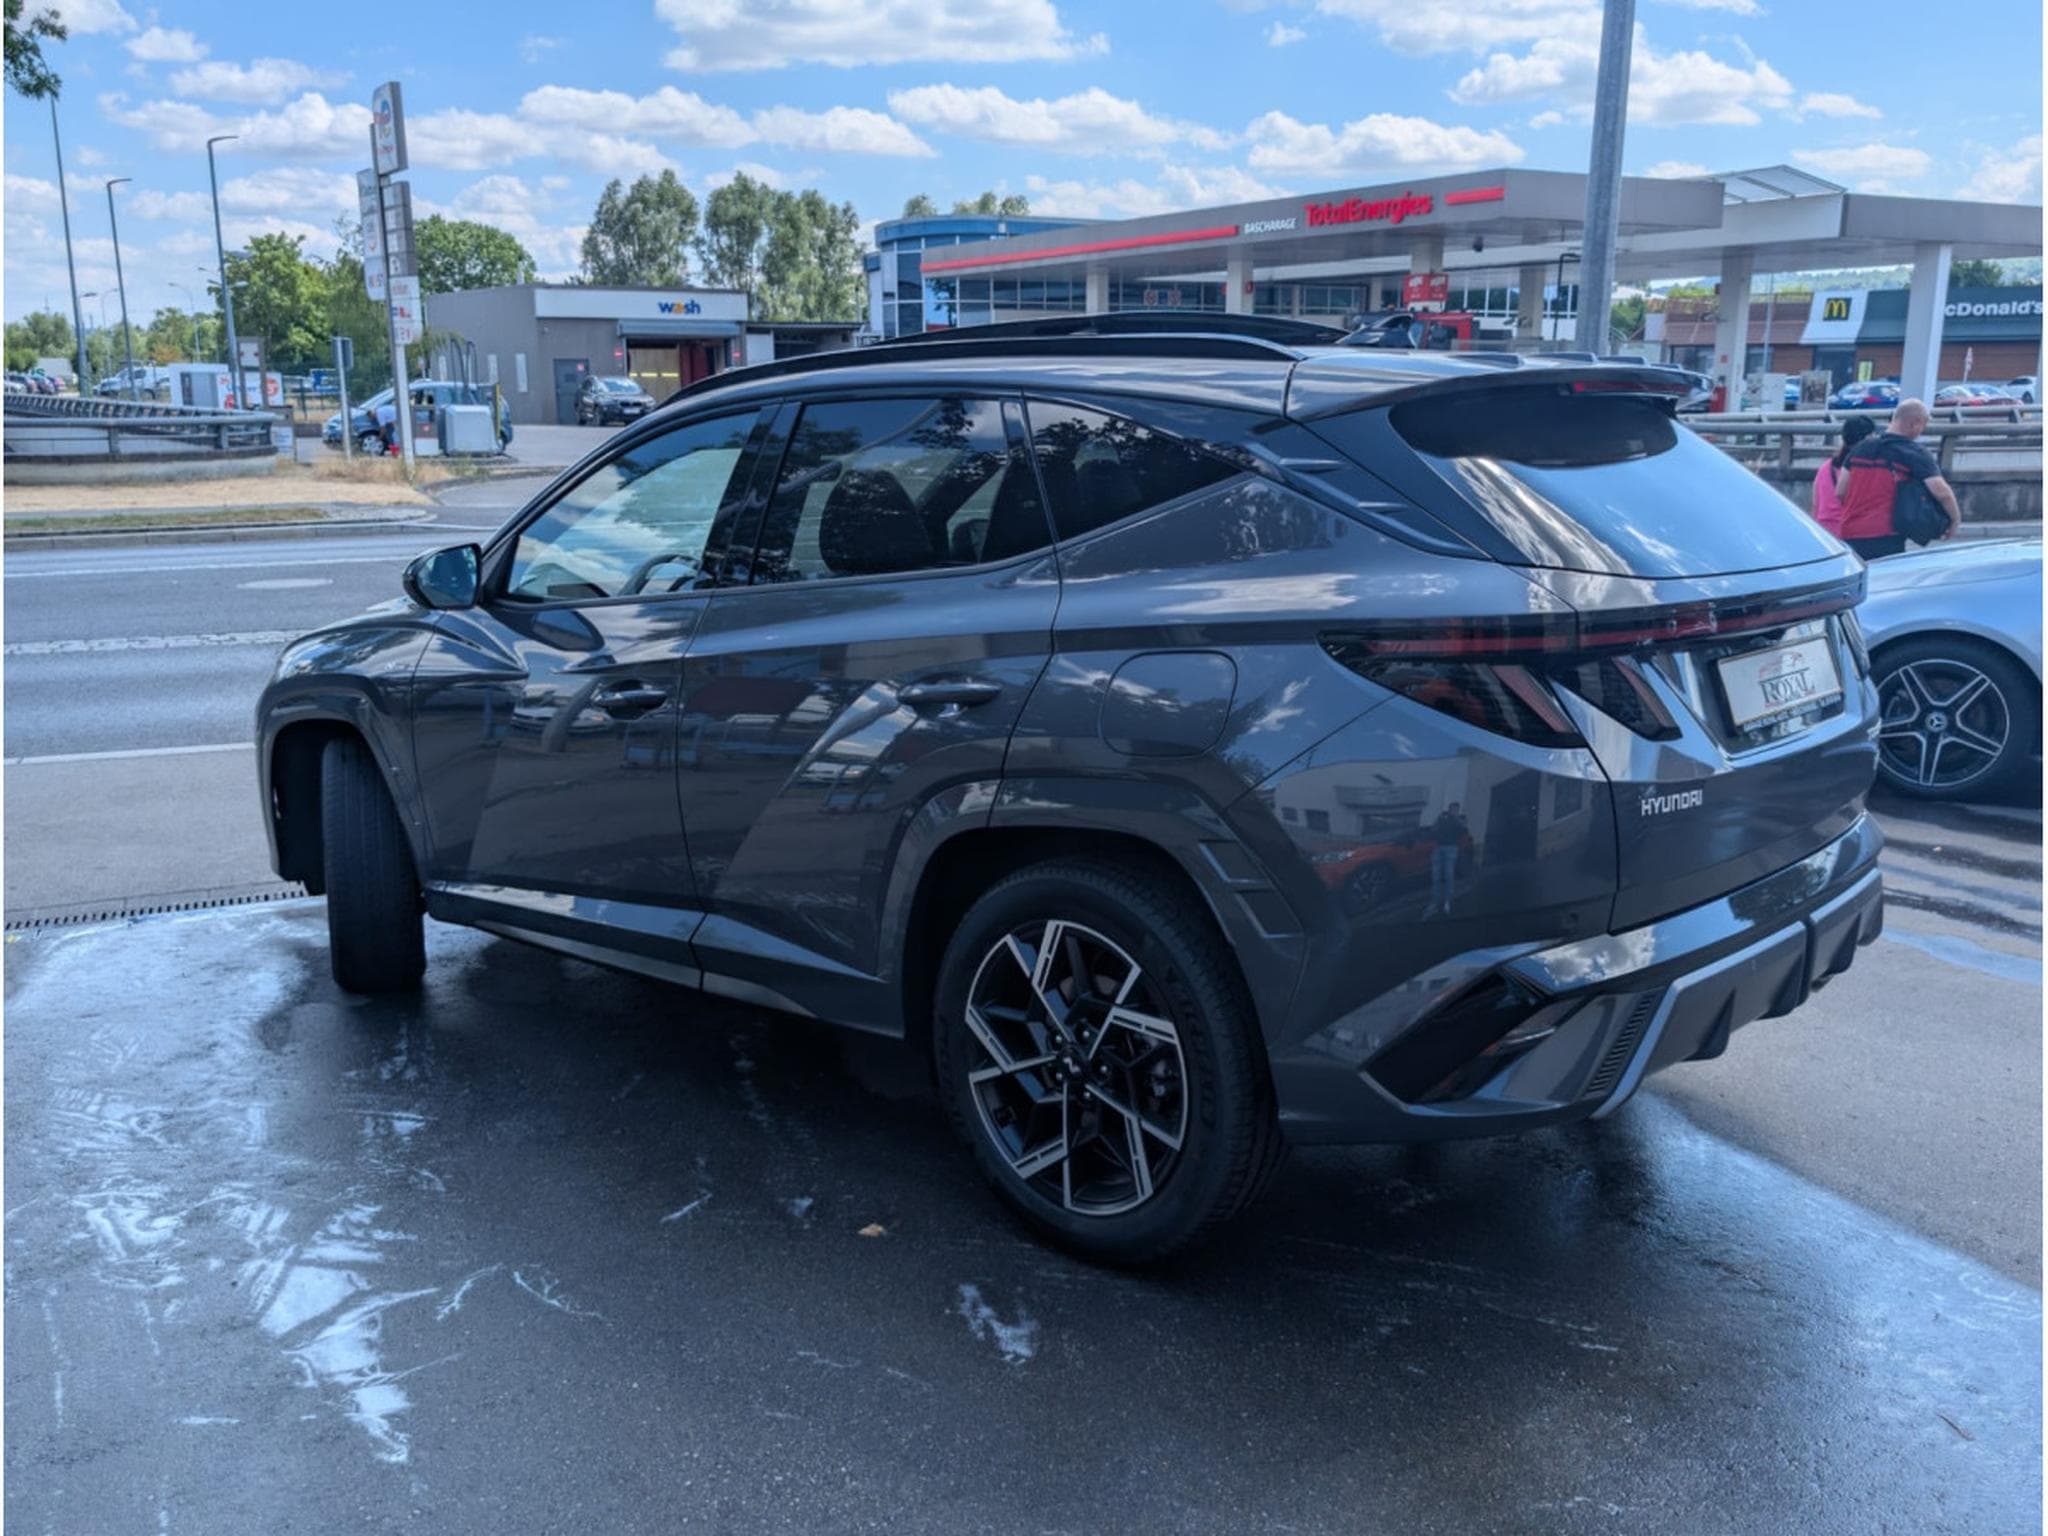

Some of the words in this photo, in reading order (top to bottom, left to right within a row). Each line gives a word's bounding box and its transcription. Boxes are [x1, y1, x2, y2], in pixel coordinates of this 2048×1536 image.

[1304, 192, 1433, 224] TotalEnergies
[1244, 217, 1297, 235] BASCHARAGE
[658, 299, 701, 315] wash
[1944, 300, 2043, 317] cDonald's
[1759, 670, 1816, 703] ROYAL
[1641, 789, 1703, 816] HYUNDAI
